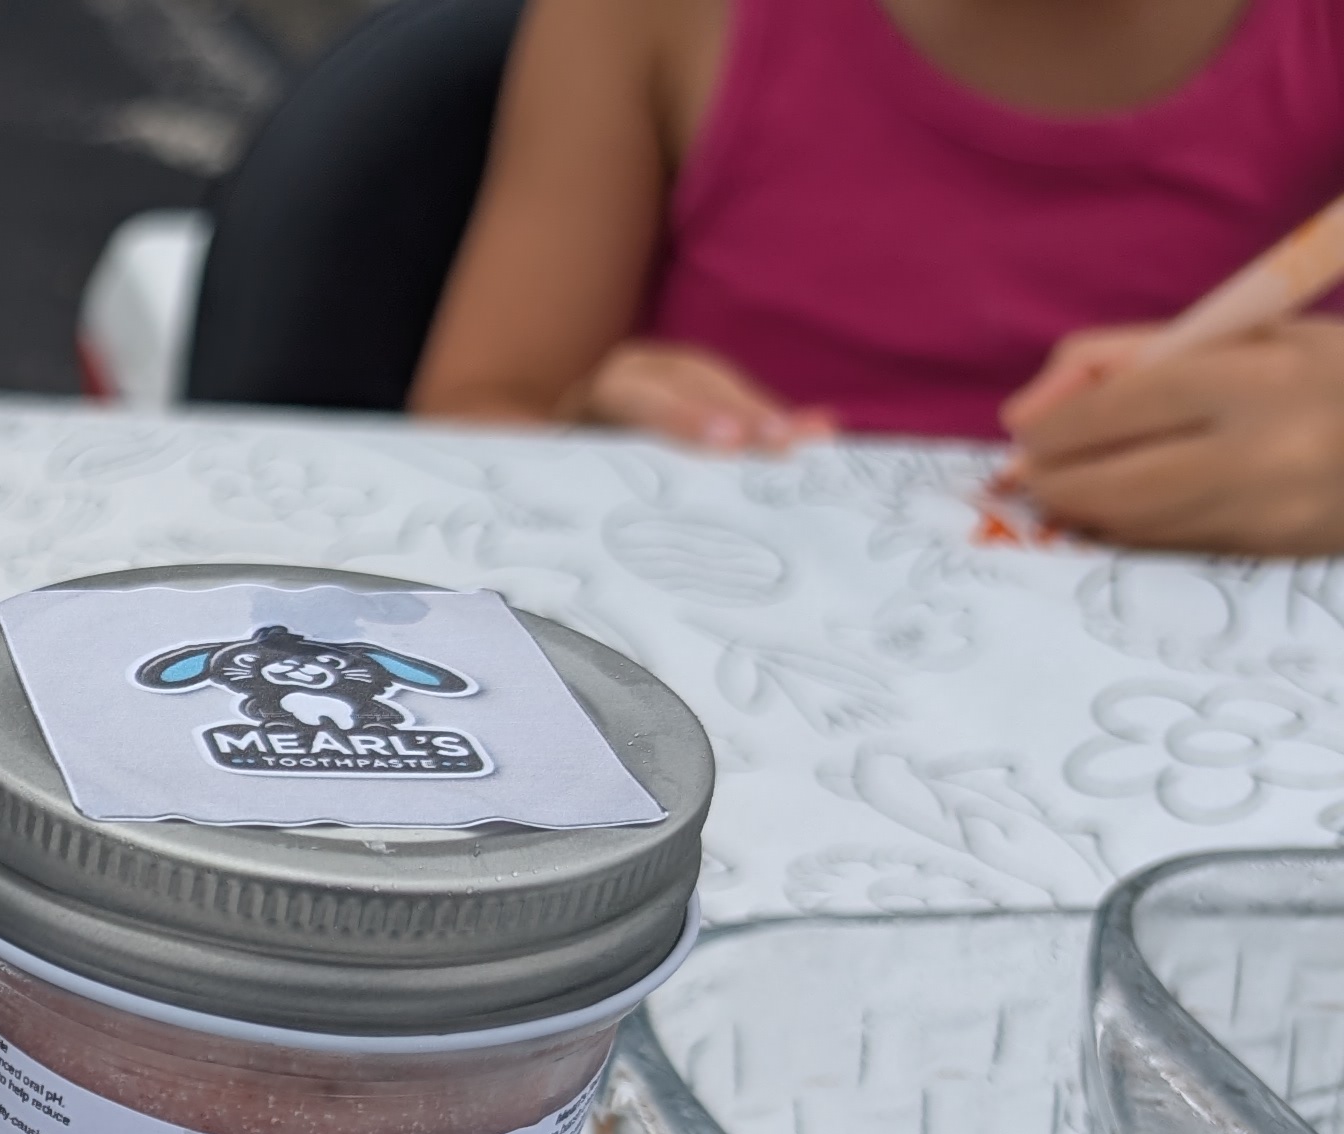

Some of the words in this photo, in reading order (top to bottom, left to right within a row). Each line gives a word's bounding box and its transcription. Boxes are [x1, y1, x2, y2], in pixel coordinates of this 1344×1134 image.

[212, 731, 470, 757] MEARL'S
[262, 755, 437, 770] TOOTHPASTE
[8, 1080, 30, 1103] help
[31, 1099, 71, 1126] reduce
[23, 1076, 45, 1095] oral
[45, 1091, 65, 1108] pH.
